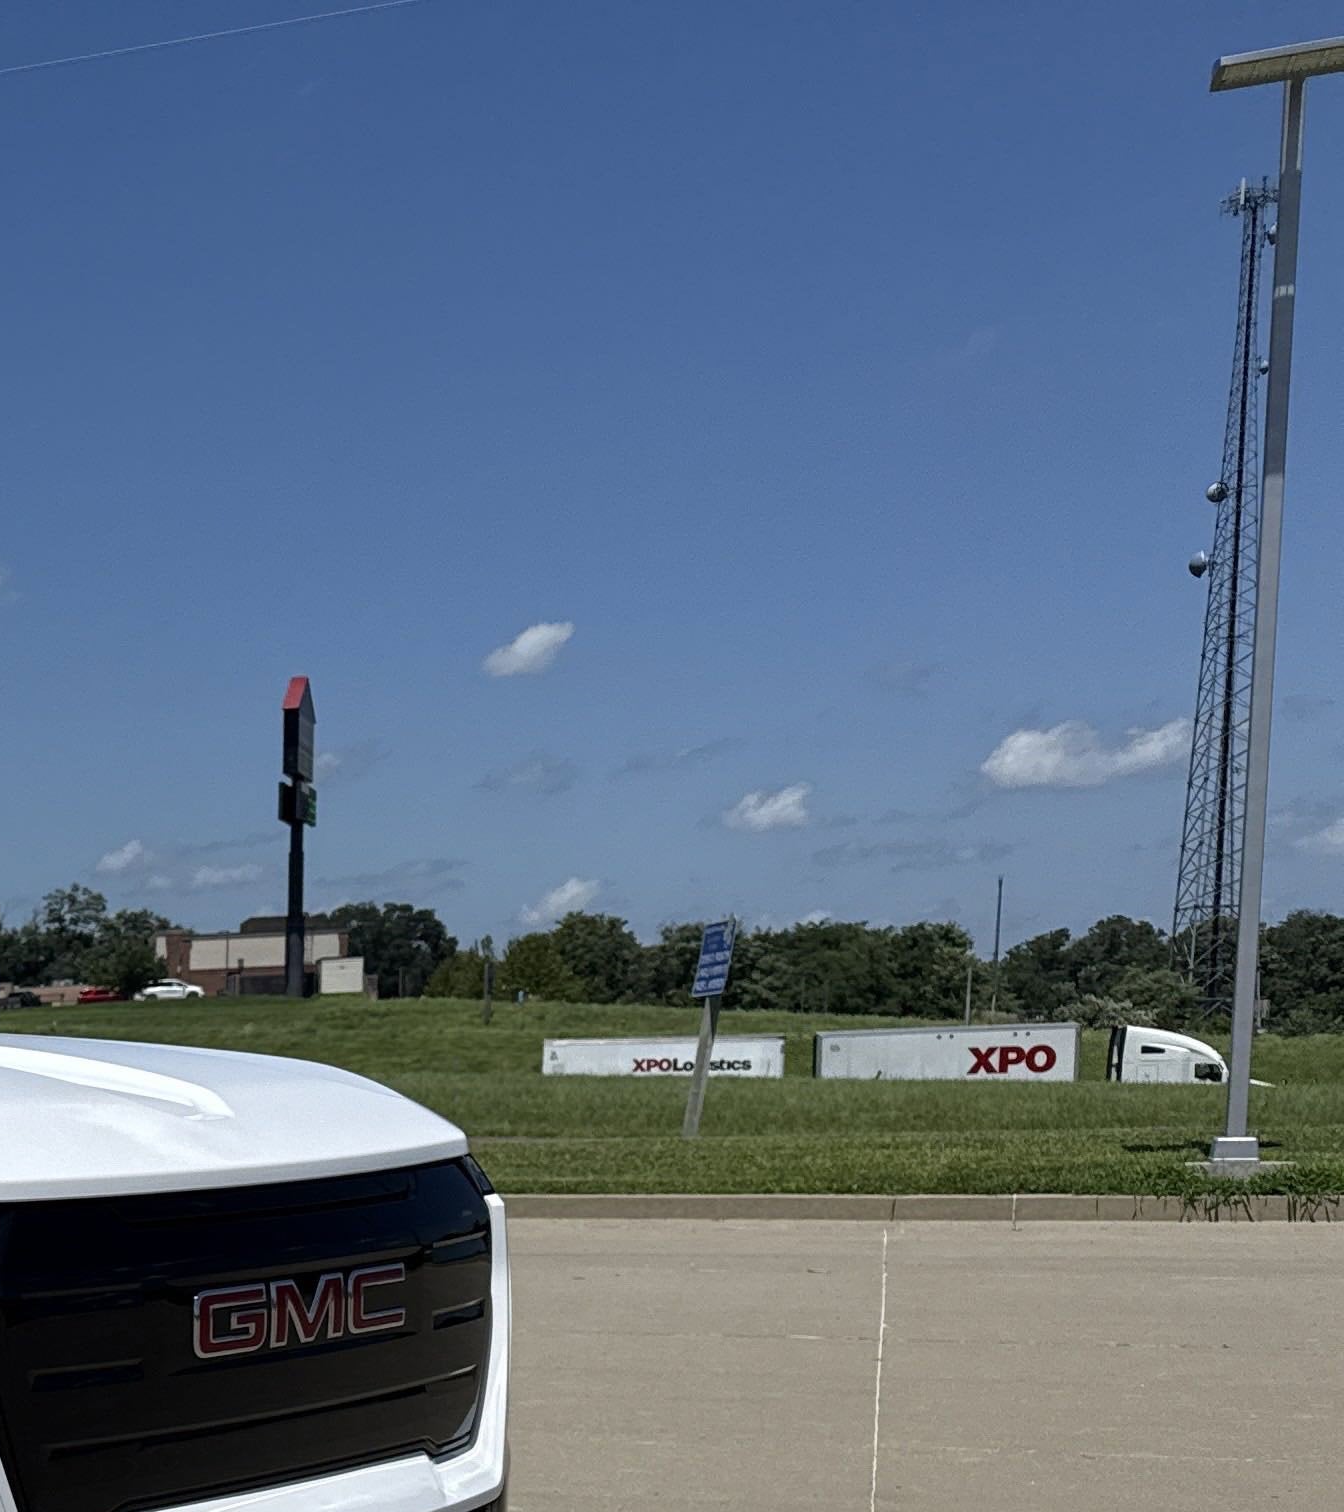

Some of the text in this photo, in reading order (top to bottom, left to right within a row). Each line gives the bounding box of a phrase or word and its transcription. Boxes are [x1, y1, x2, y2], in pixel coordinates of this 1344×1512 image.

[632, 1058, 752, 1073] XPOLostics
[967, 1044, 1057, 1075] XPO
[193, 1262, 406, 1359] GMC
